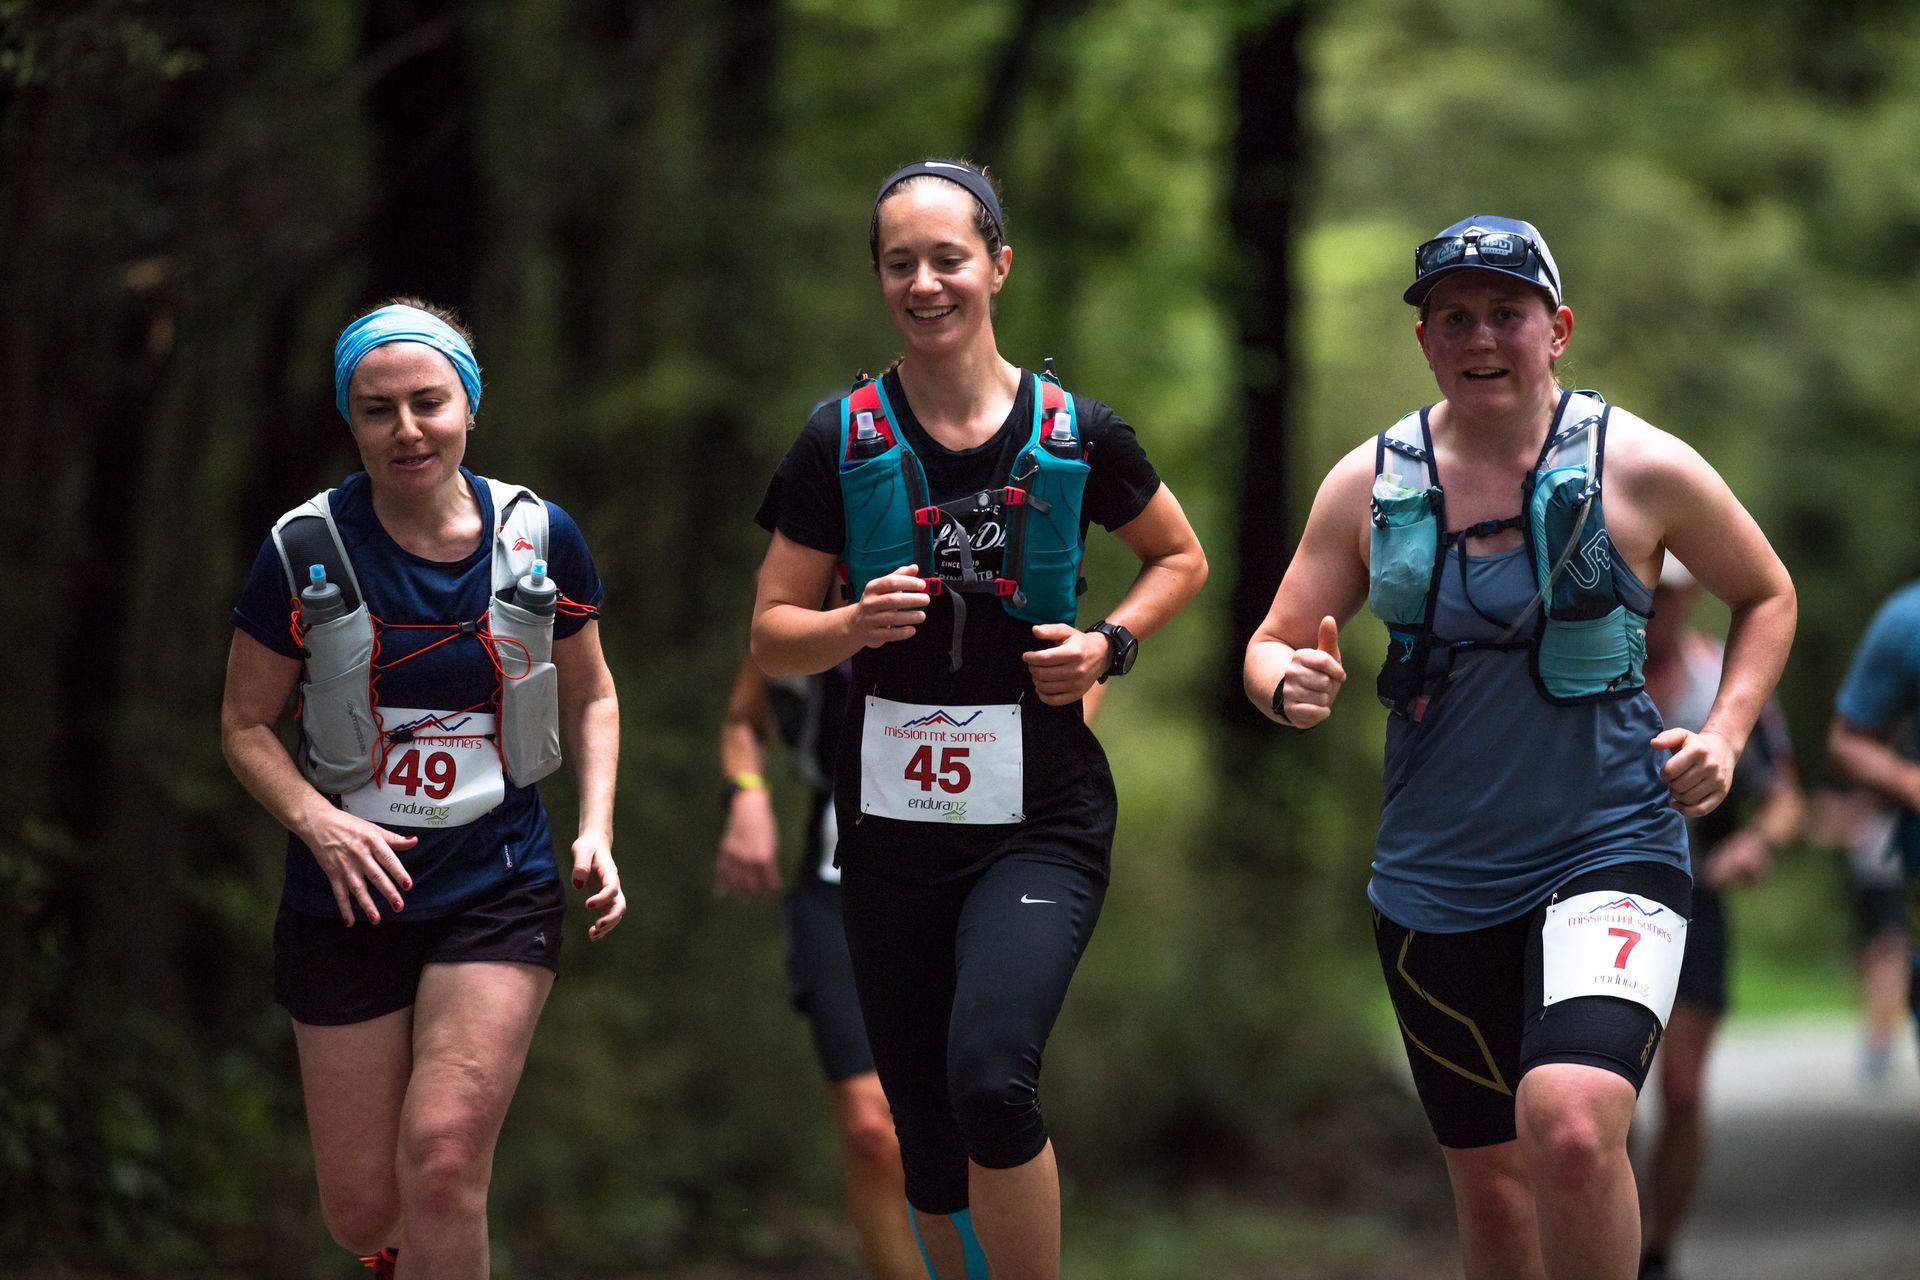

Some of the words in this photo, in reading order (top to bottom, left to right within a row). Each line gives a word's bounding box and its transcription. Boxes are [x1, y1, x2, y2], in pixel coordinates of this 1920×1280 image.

[941, 560, 961, 569] SINCE
[884, 725, 928, 741] mission
[930, 730, 946, 742] mt
[950, 731, 997, 743] somers
[438, 737, 482, 750] somers
[388, 749, 457, 800] 49
[904, 745, 971, 794] 45
[390, 802, 450, 819] enduranz
[908, 797, 967, 812] enduranz
[1568, 913, 1615, 927] mission
[1617, 914, 1633, 925] mt
[1637, 918, 1673, 943] somers
[1608, 927, 1641, 969] 7
